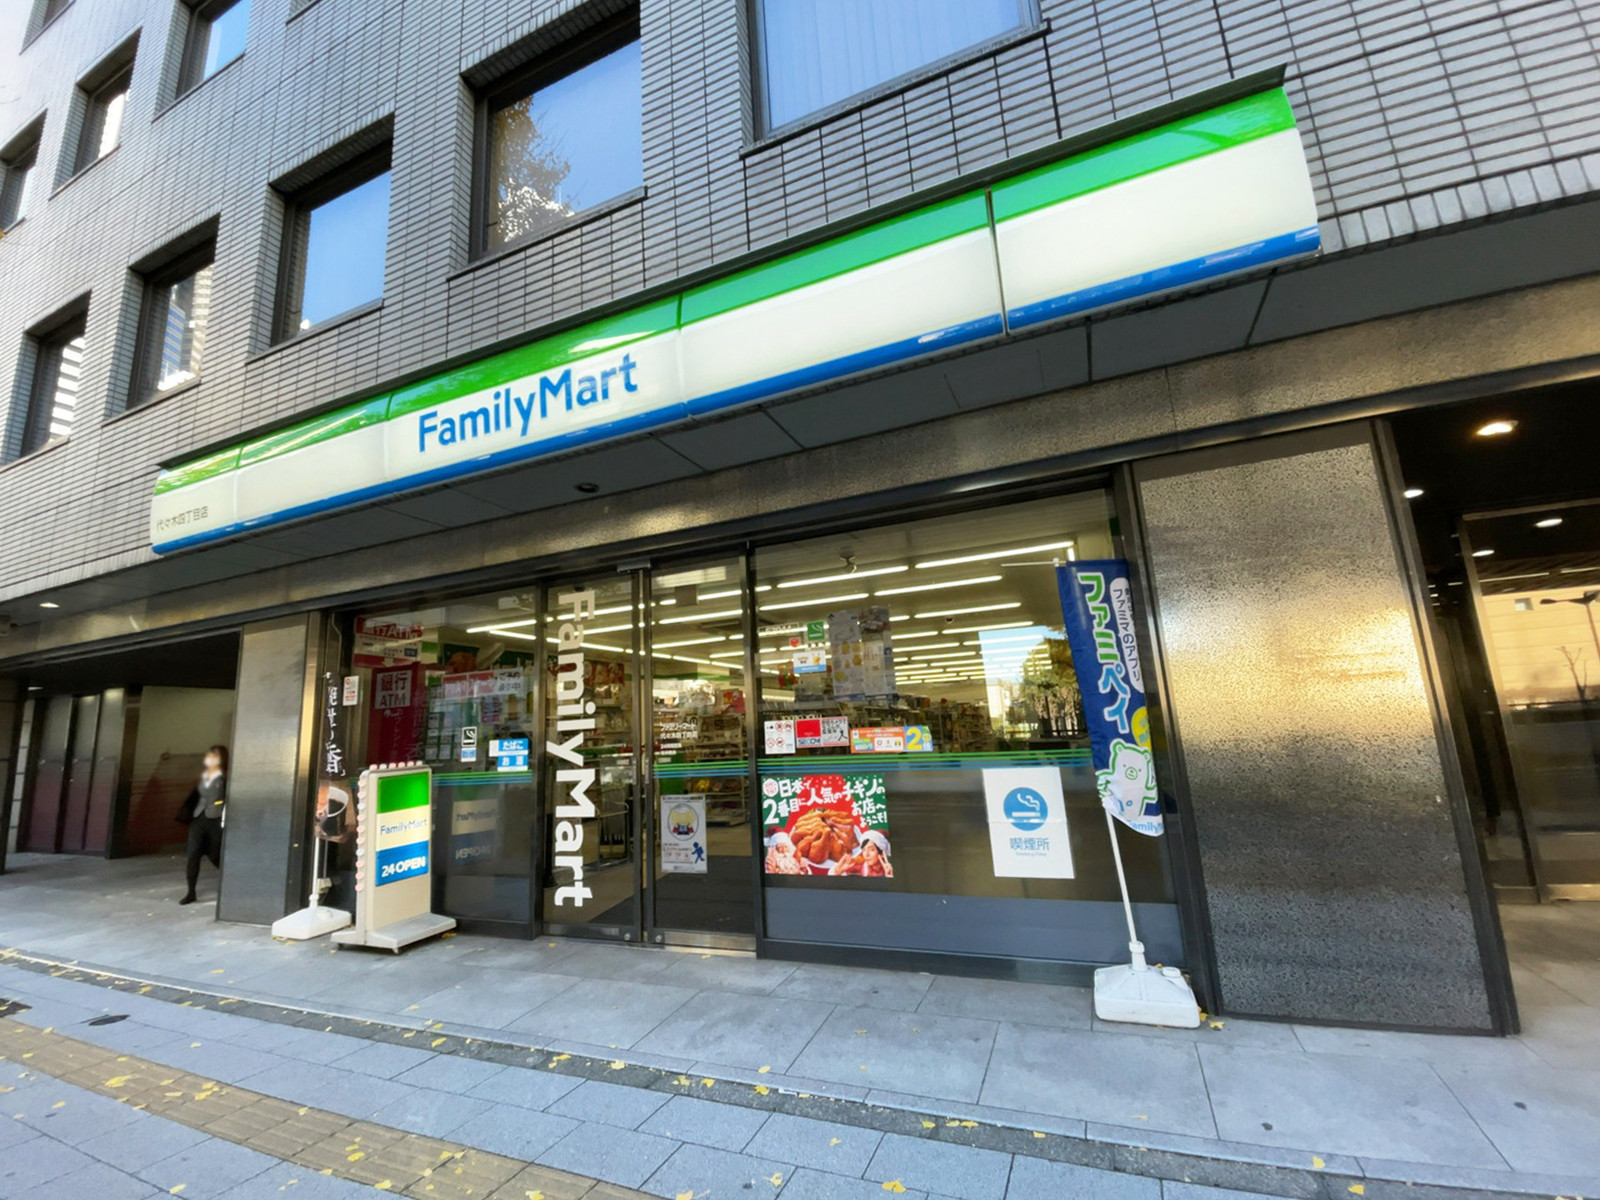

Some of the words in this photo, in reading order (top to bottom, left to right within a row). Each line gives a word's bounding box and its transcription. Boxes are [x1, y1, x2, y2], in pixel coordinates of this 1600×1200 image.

[419, 353, 638, 453] FamilyMart
[156, 505, 208, 532] 代々木四丁目店
[1112, 588, 1141, 683] ファミマのアプリ
[1077, 572, 1131, 734] ファミペイ
[380, 672, 408, 692] 銀行
[379, 693, 407, 708] ATM
[503, 740, 524, 750] たばこ
[546, 589, 596, 907] FamilyMart
[779, 779, 813, 797] 日本で
[851, 798, 886, 816] お店へ
[380, 819, 428, 836] FamilyMart
[1009, 837, 1050, 851] 喫煙所
